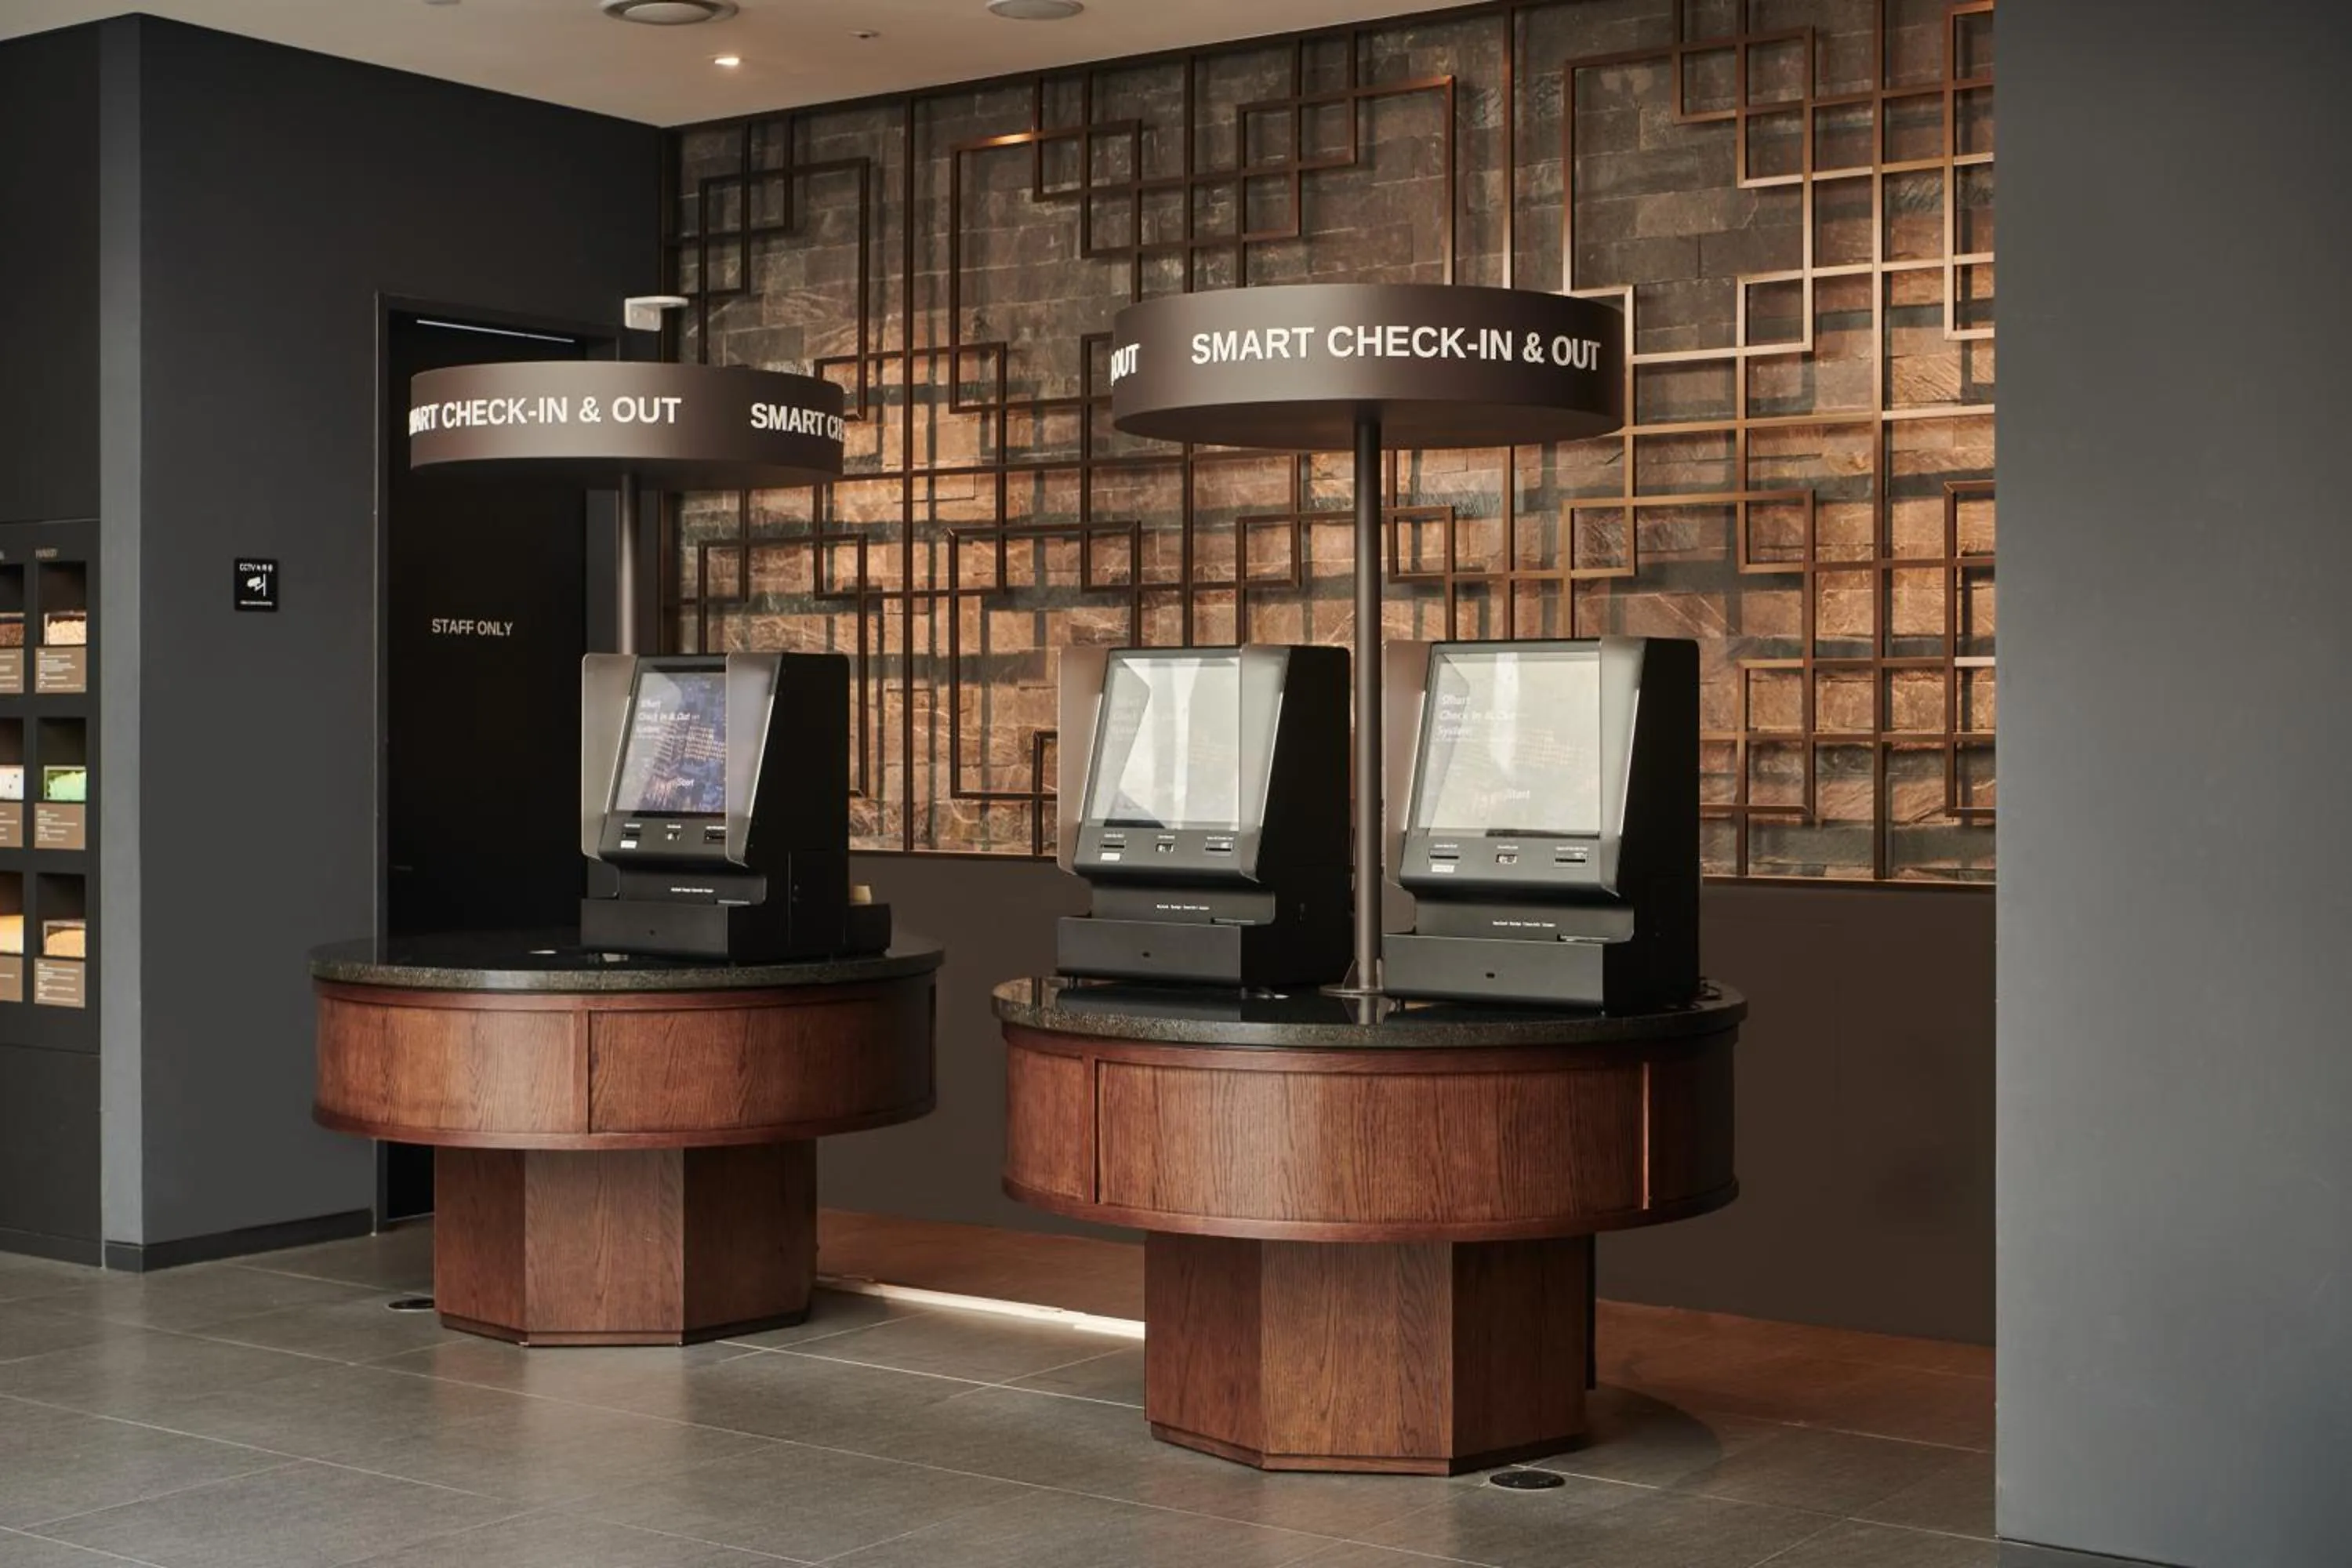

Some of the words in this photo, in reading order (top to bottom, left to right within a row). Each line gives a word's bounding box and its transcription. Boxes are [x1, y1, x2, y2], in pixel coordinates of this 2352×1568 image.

[1113, 343, 1141, 379] OUT
[1191, 325, 1316, 365] SMART
[1327, 325, 1512, 361] CHECK-IN
[1523, 332, 1544, 363] &
[1552, 336, 1600, 371] OUT
[409, 403, 440, 436] ART
[441, 396, 568, 429] CHECK-IN
[579, 396, 602, 423] &
[612, 397, 681, 423] OUT
[750, 402, 826, 437] SMART
[432, 618, 474, 634] STAFF
[477, 621, 513, 637] ONLY
